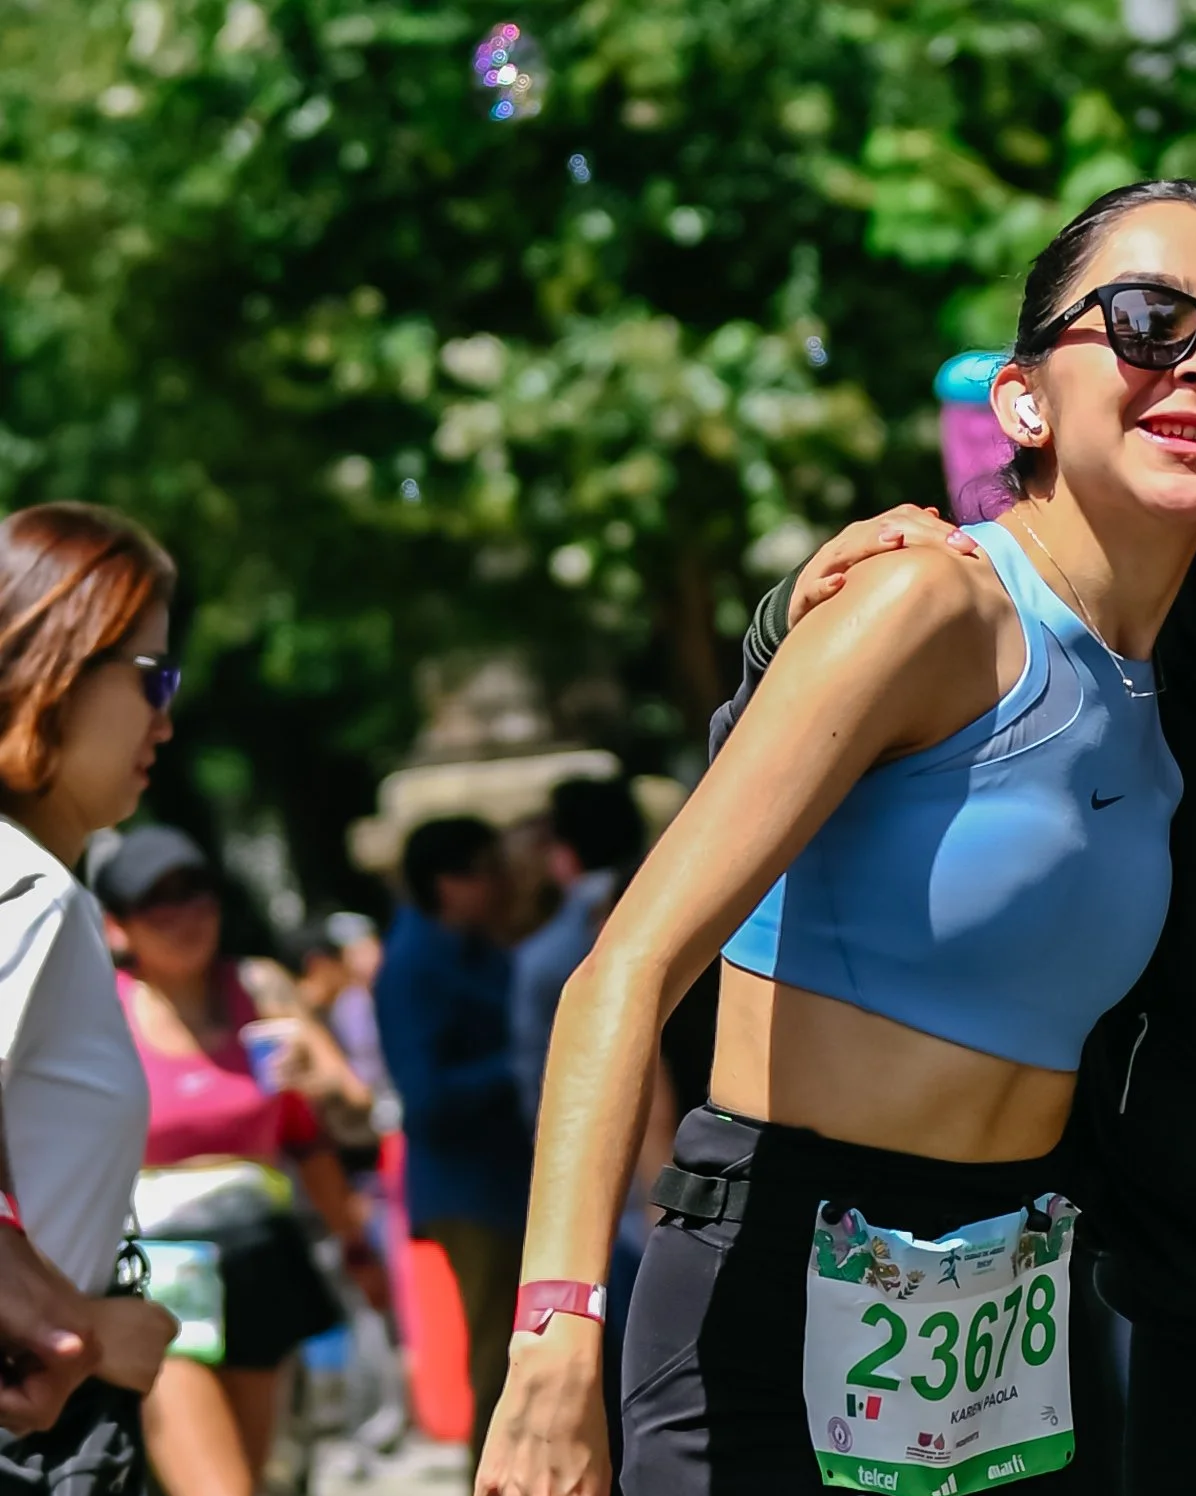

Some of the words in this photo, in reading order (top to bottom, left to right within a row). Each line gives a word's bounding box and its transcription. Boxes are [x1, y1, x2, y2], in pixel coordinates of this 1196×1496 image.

[846, 1273, 1057, 1402] 23678
[950, 1400, 983, 1425] KAREN
[983, 1385, 1019, 1411] PAOLA
[857, 1465, 899, 1492] telcel
